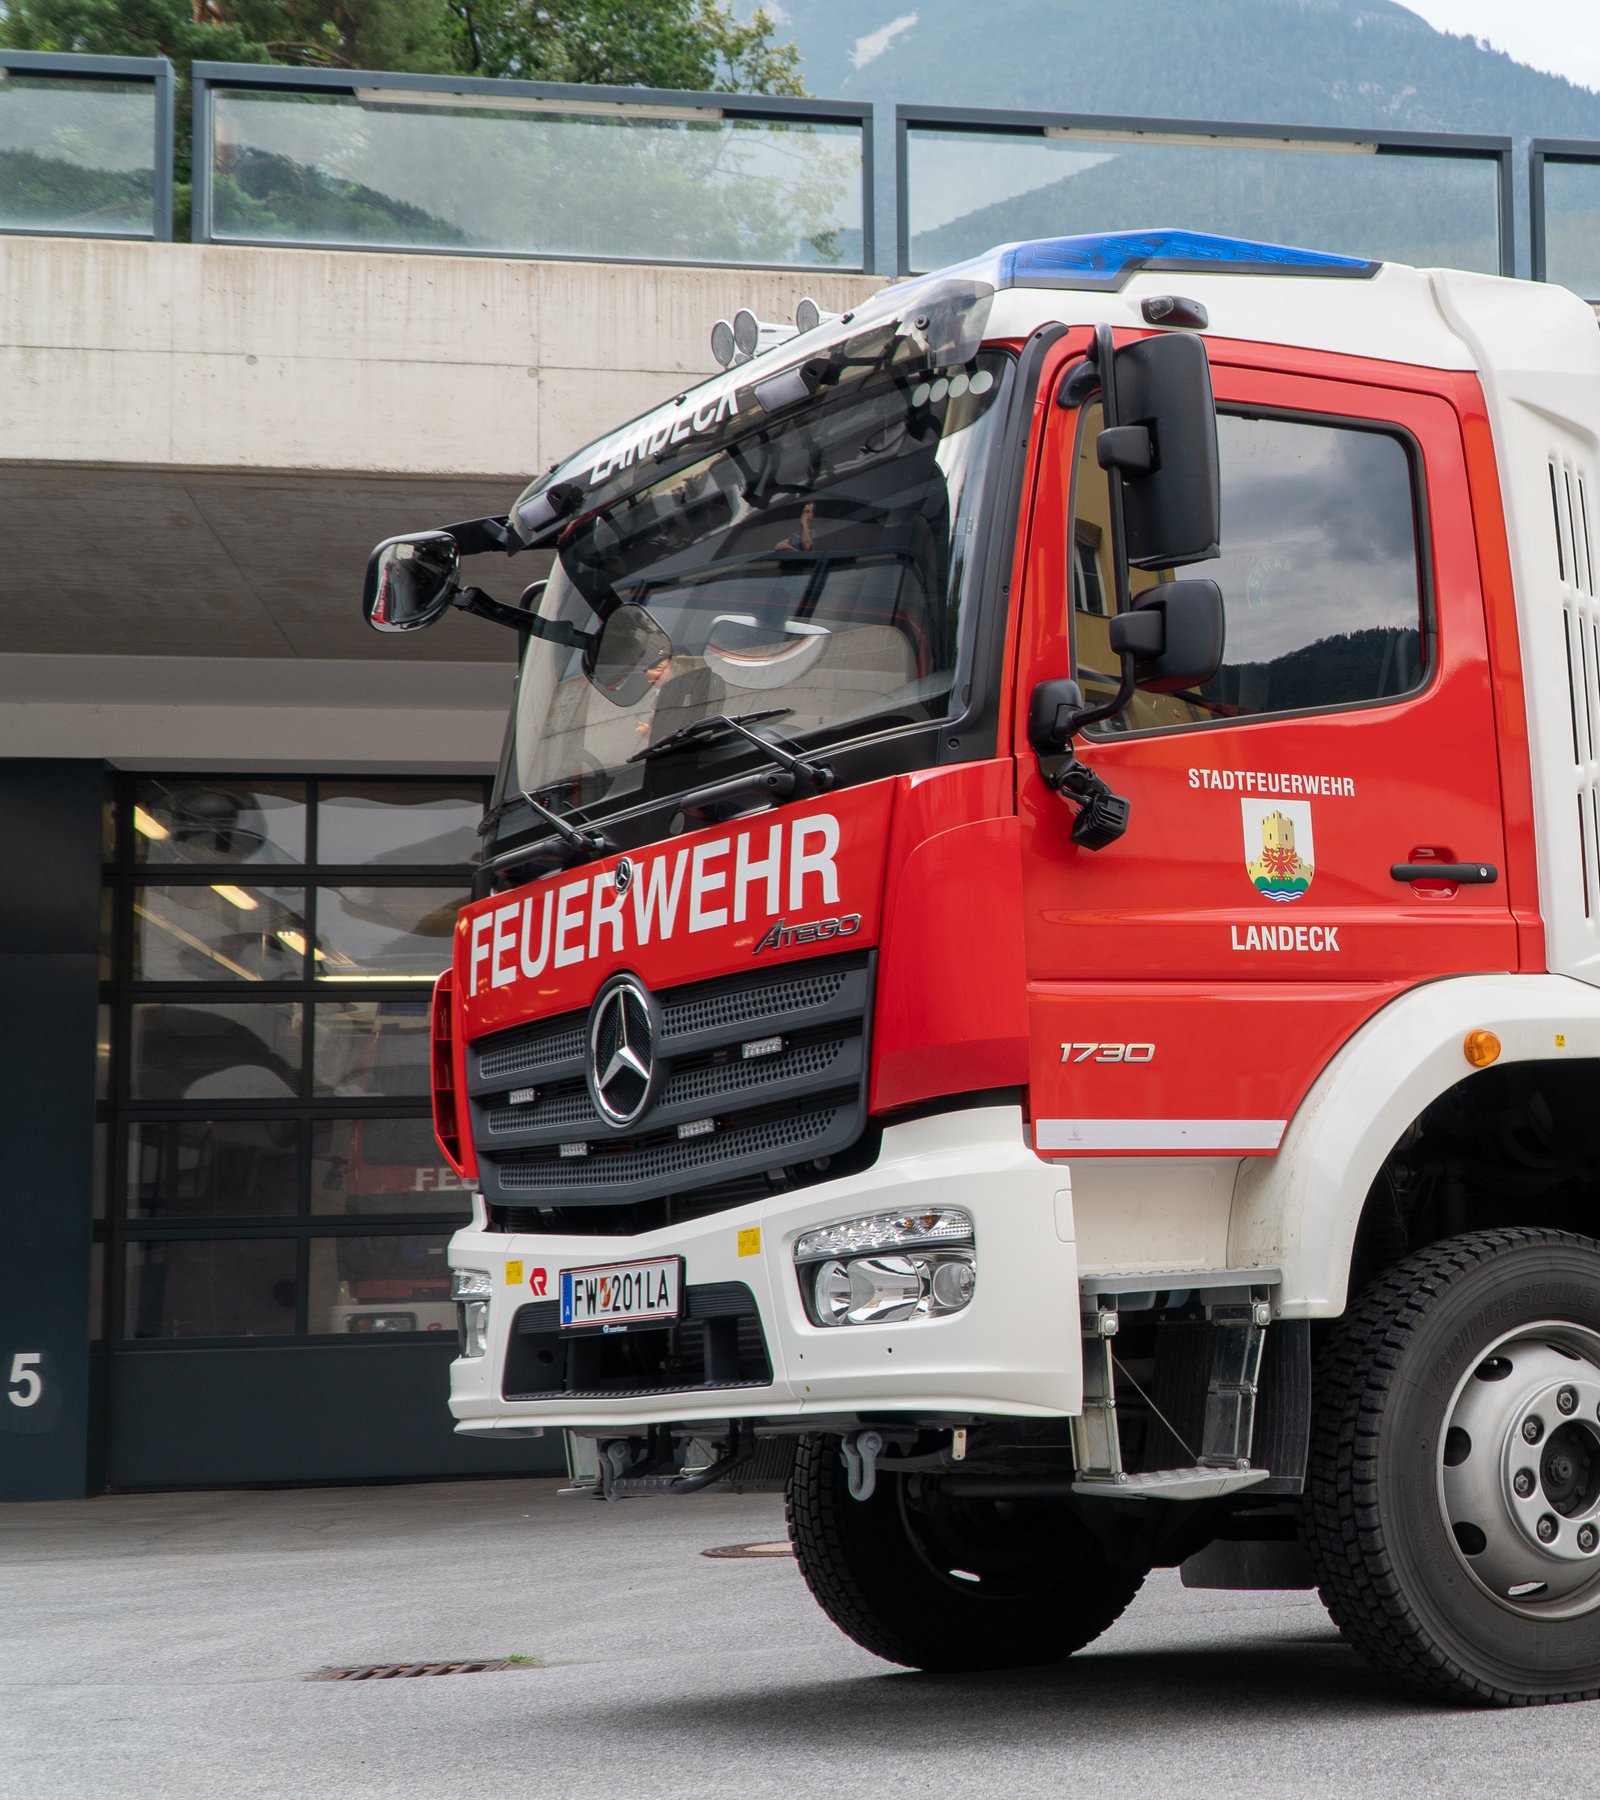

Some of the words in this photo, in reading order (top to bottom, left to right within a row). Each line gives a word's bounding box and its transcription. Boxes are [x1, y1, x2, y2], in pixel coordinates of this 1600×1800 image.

[1188, 768, 1355, 797] STADTFEUERWEHR
[470, 813, 840, 997] FEUERWEHR
[1231, 925, 1340, 951] LANDECK
[1060, 1043, 1155, 1063] 1730
[574, 1277, 598, 1316] FW
[612, 1268, 669, 1312] 201LA
[8, 1352, 42, 1407] 5
